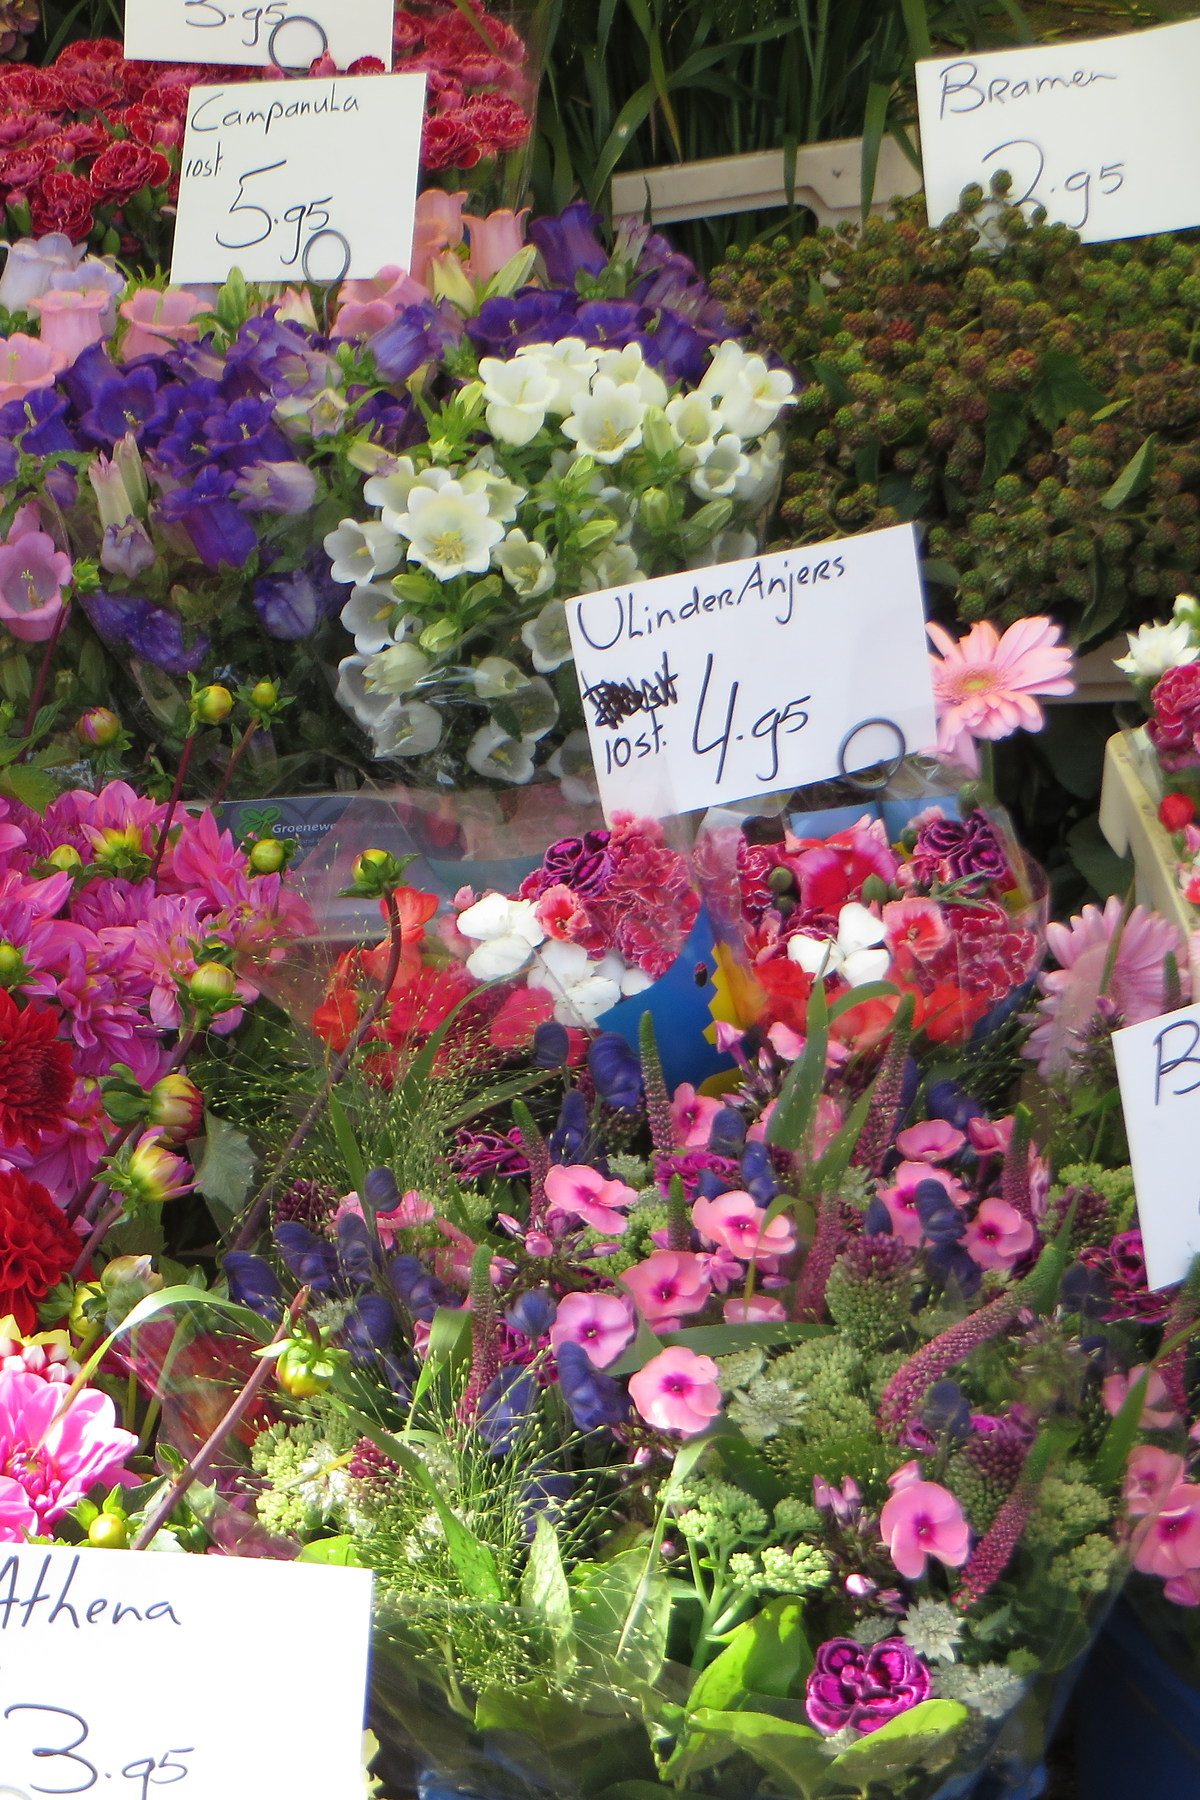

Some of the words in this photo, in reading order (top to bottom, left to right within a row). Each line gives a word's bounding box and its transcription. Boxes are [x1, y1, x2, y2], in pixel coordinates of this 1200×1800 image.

[215, 159, 334, 265] 5.95
[981, 139, 1125, 229] 2.95
[692, 652, 811, 784] 4.95
[3, 1702, 196, 1800] 3.95
